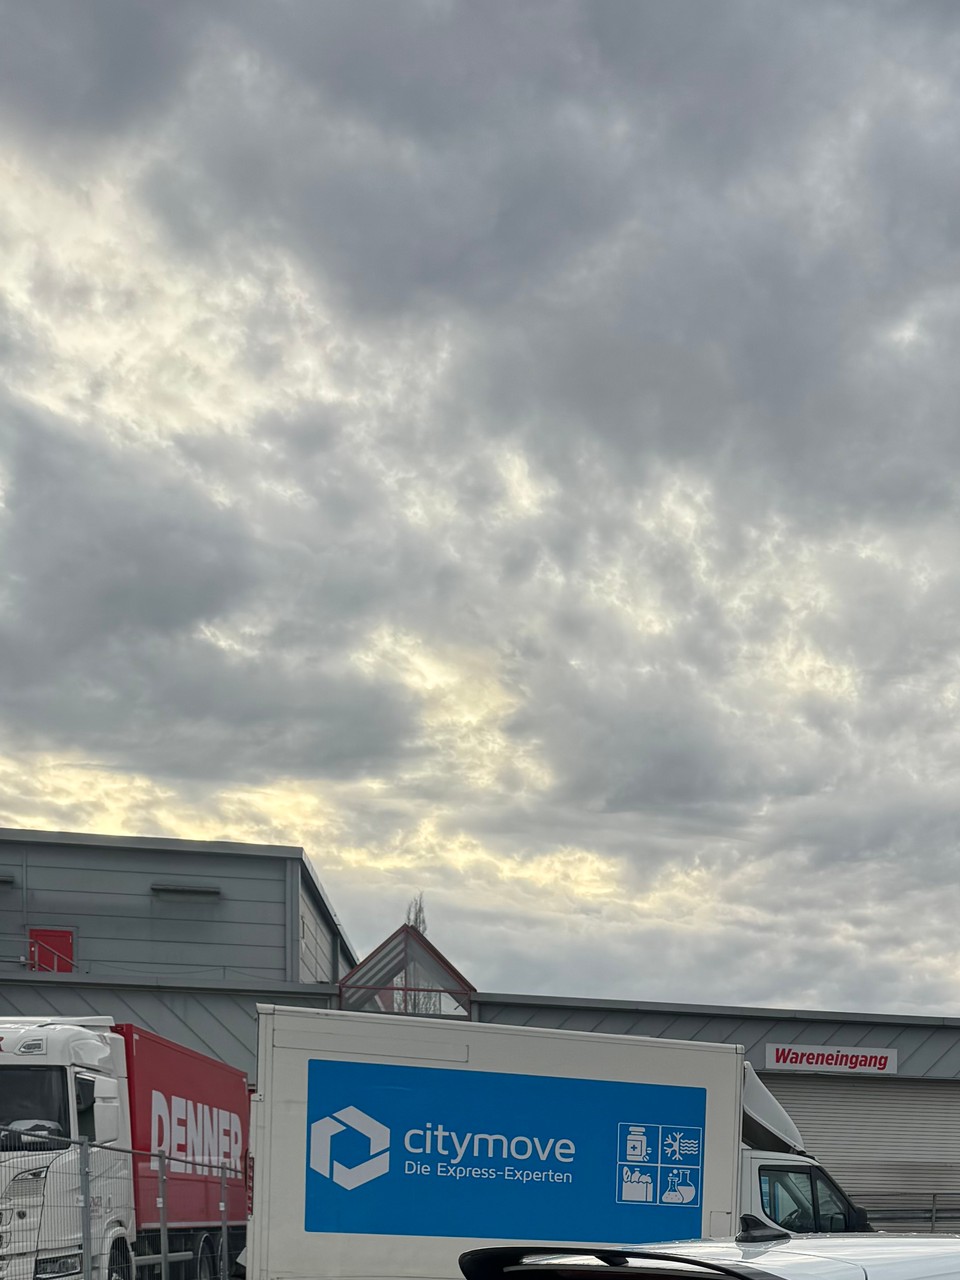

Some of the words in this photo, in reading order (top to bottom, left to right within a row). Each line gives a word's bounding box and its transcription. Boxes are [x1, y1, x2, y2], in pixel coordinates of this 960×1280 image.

[775, 1048, 889, 1071] Wareneingang
[150, 1089, 243, 1179] DENNER
[404, 1122, 576, 1164] citymove
[404, 1160, 431, 1175] Die
[437, 1162, 573, 1184] Express-Experten
